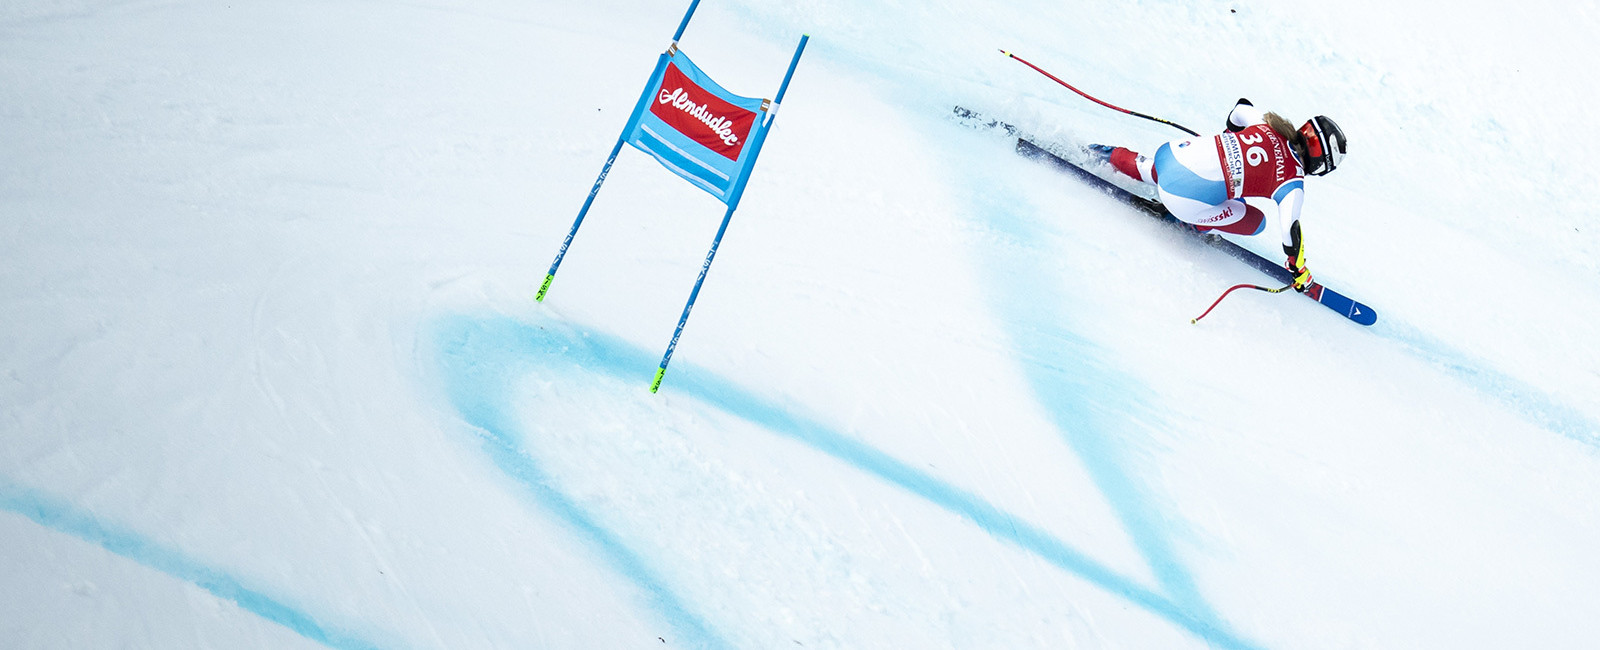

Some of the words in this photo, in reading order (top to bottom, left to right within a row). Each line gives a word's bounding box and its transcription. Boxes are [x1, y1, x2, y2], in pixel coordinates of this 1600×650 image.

[658, 87, 738, 146] Almdudler
[1238, 132, 1269, 167] 36
[1265, 131, 1285, 182] GENERALI
[593, 156, 615, 193] LISKI
[553, 228, 574, 264] LISKI
[696, 243, 716, 281] LISKI
[535, 275, 551, 301] LISKI
[666, 321, 686, 359] LISKI
